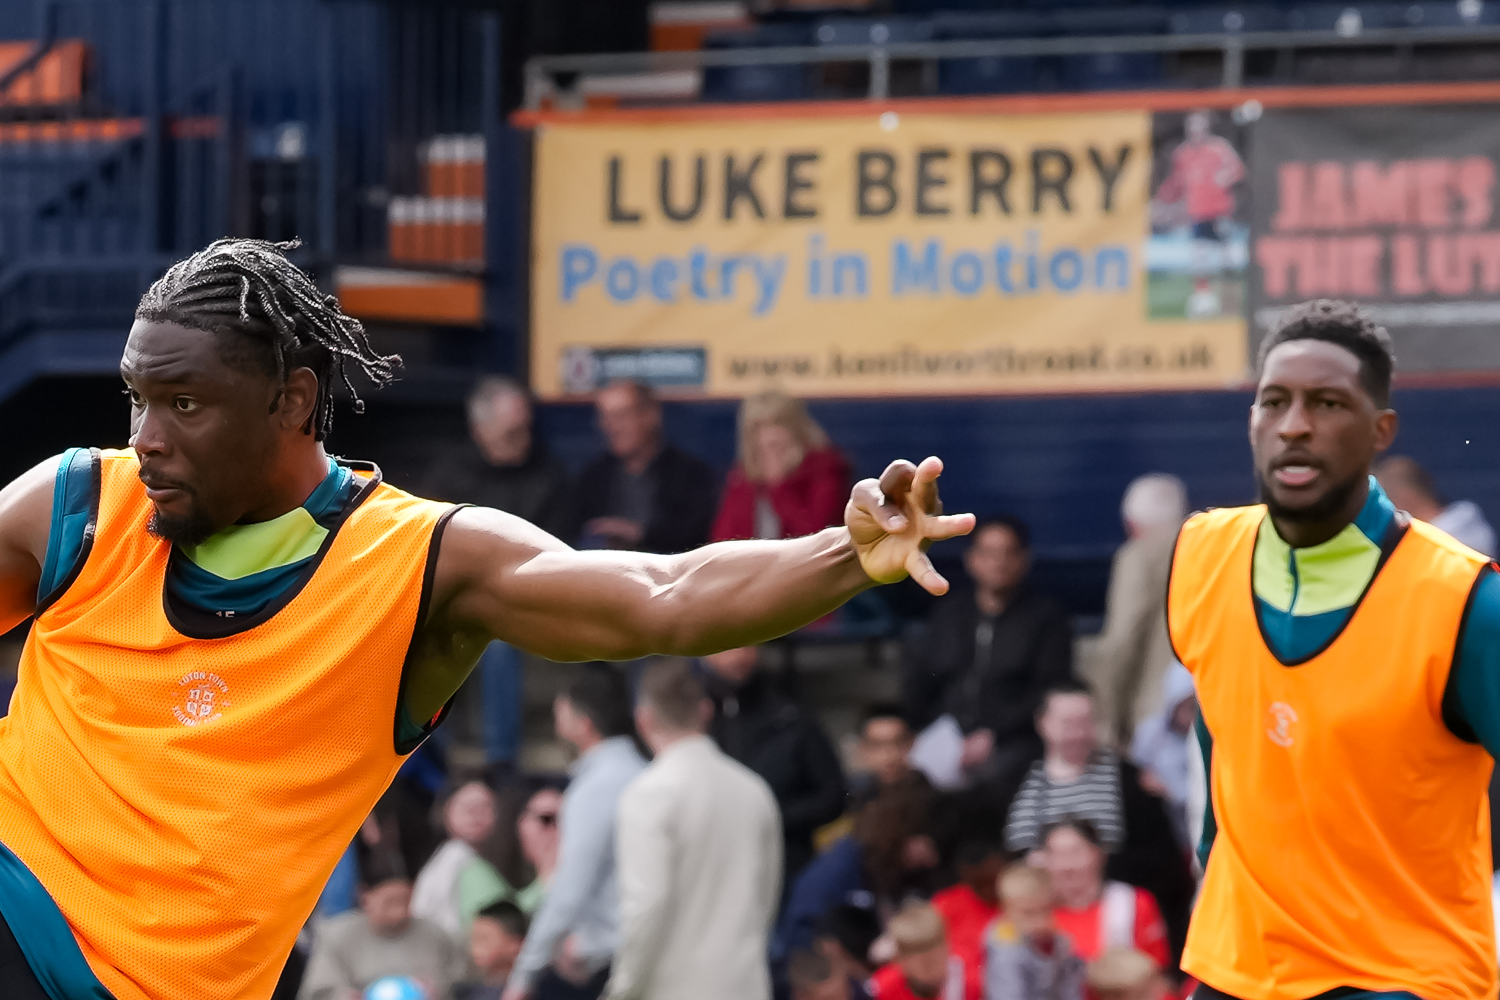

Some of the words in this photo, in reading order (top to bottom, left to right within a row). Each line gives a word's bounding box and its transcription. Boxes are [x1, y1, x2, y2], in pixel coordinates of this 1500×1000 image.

[607, 151, 821, 224] LUKE
[855, 142, 1135, 219] BERRY
[1273, 156, 1493, 230] JAMES
[559, 244, 787, 316] Poetry
[808, 233, 869, 296] in
[892, 230, 1130, 297] Motion
[1257, 233, 1382, 296] THE
[178, 671, 206, 686] LUTON
[208, 672, 229, 693] TOWN
